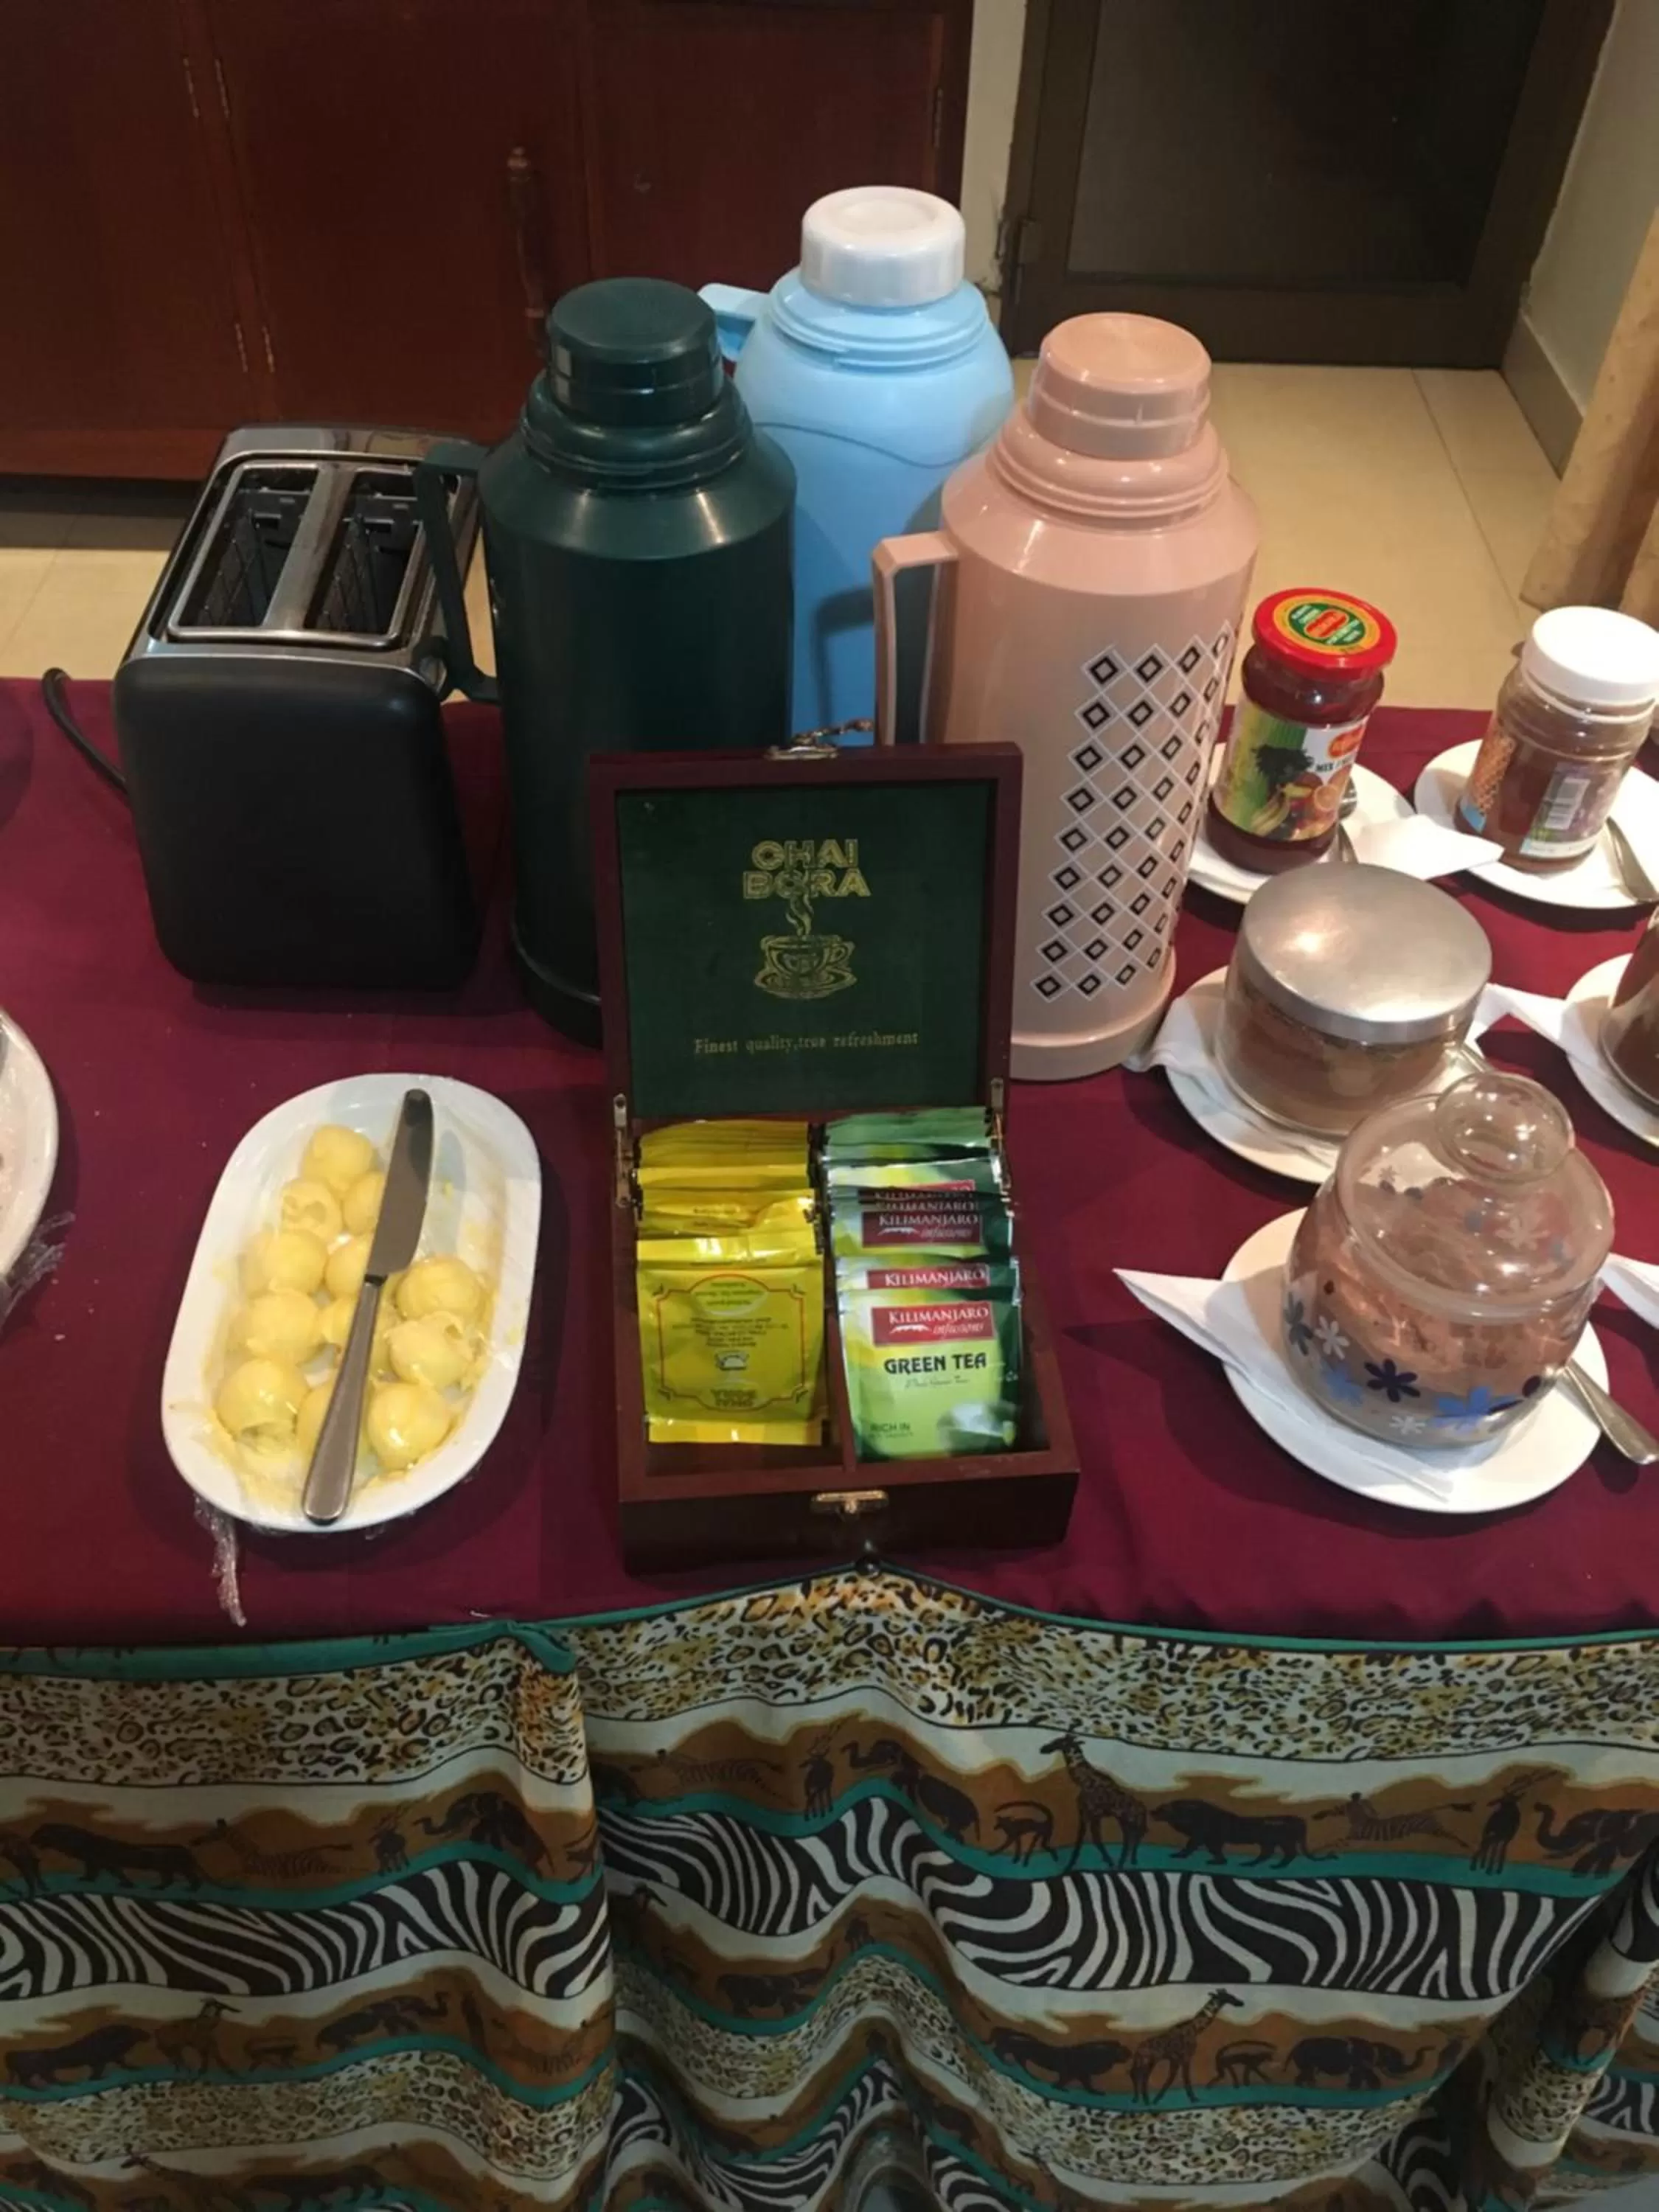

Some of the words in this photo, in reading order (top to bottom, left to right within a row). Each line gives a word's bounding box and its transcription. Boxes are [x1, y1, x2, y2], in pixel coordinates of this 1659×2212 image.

[751, 839, 858, 870] CHAI
[743, 868, 872, 899] BORA
[694, 1038, 738, 1054] Finest
[833, 1032, 919, 1048] refreshment
[879, 1214, 979, 1226] KILIMANJARO
[885, 1268, 986, 1287] KILIMANJARO
[888, 1307, 989, 1324] KILIMANJARO
[884, 1355, 946, 1375] GREEN
[952, 1352, 987, 1370] TEA
